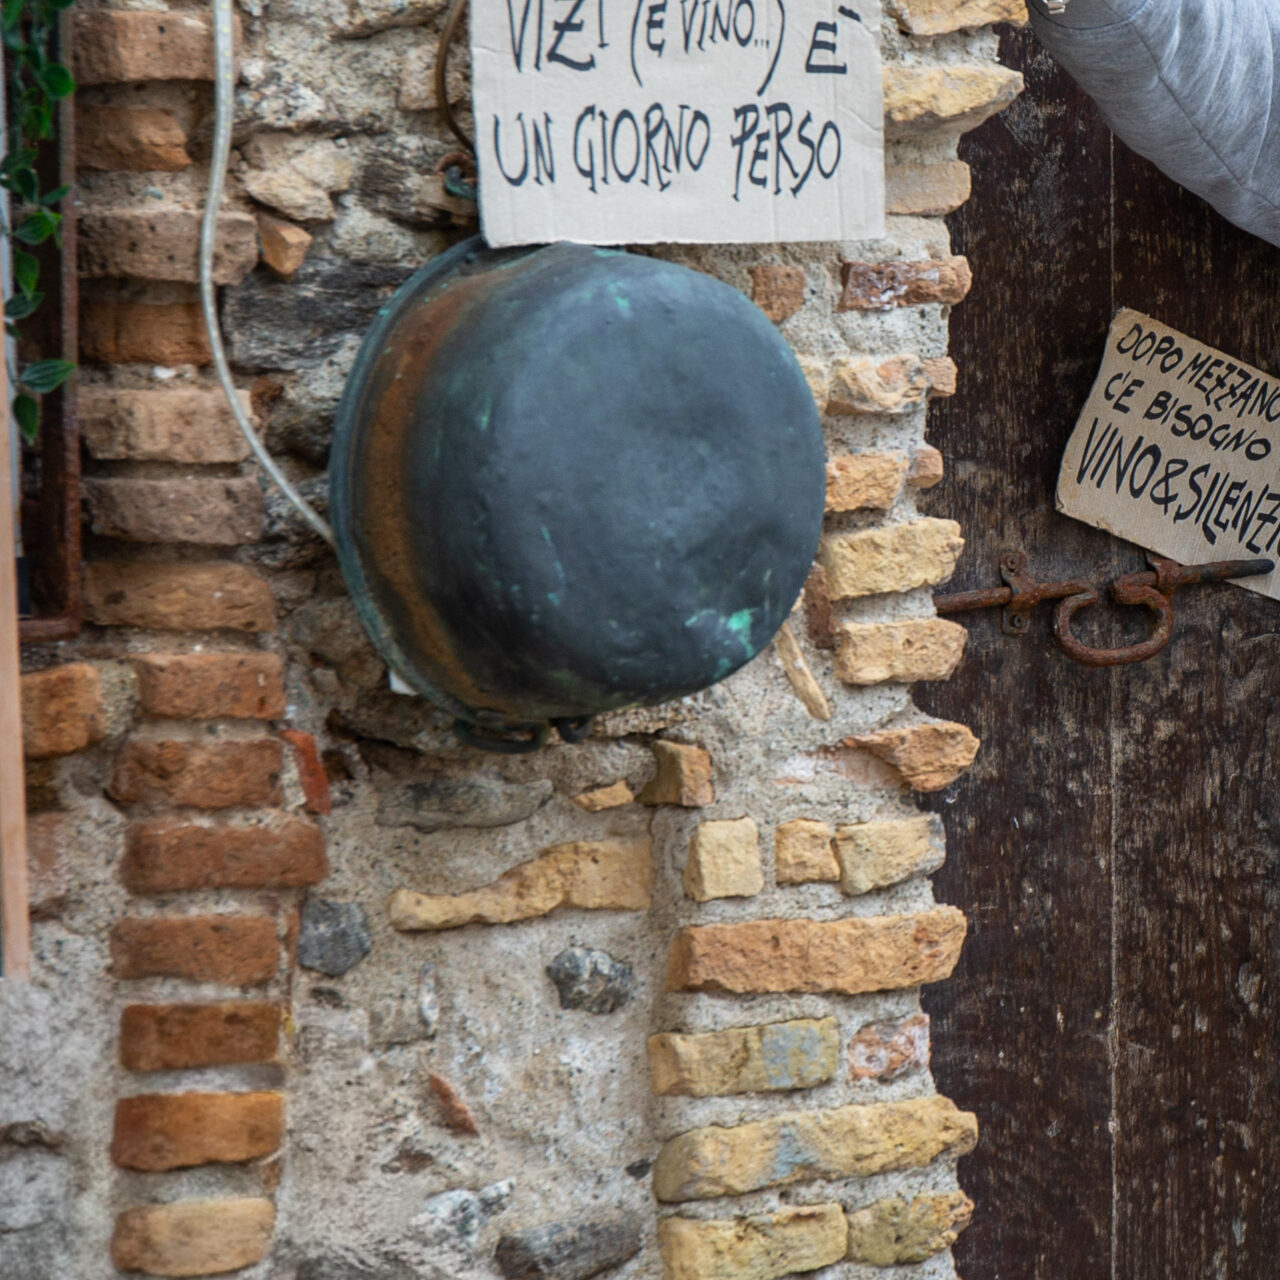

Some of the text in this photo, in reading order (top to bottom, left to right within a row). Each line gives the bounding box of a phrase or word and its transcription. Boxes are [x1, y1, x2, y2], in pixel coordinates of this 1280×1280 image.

[492, 100, 842, 203] UN GIORNO PERSO
[1116, 323, 1184, 374] DOPO
[1142, 390, 1272, 462] BISOGNO
